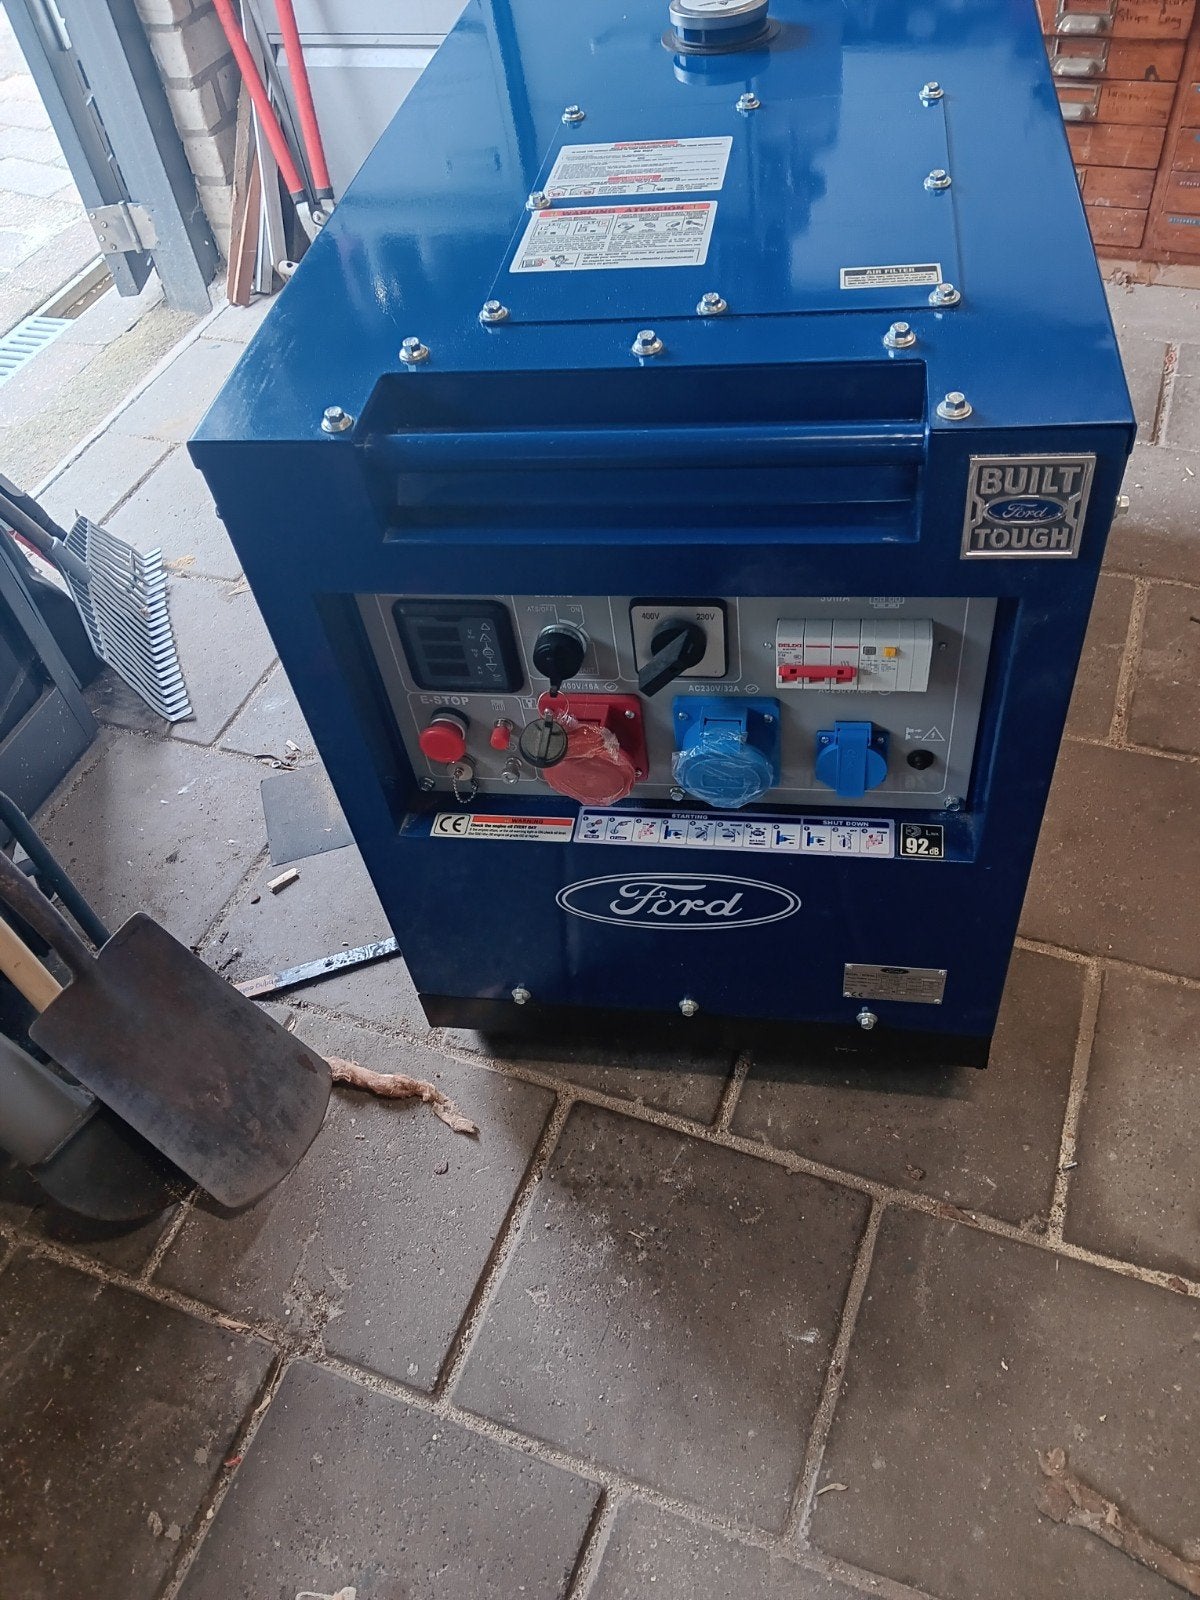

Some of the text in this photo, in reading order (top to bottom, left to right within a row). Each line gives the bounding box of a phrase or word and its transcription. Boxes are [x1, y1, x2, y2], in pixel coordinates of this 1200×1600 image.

[980, 466, 1081, 494] BUILT
[1002, 503, 1048, 518] Ford
[975, 528, 1069, 549] TOUGH
[641, 612, 660, 620] 400V
[420, 695, 469, 706] E-STOP
[439, 816, 465, 832] CE
[906, 838, 929, 855] 92
[609, 882, 744, 916] Ford
